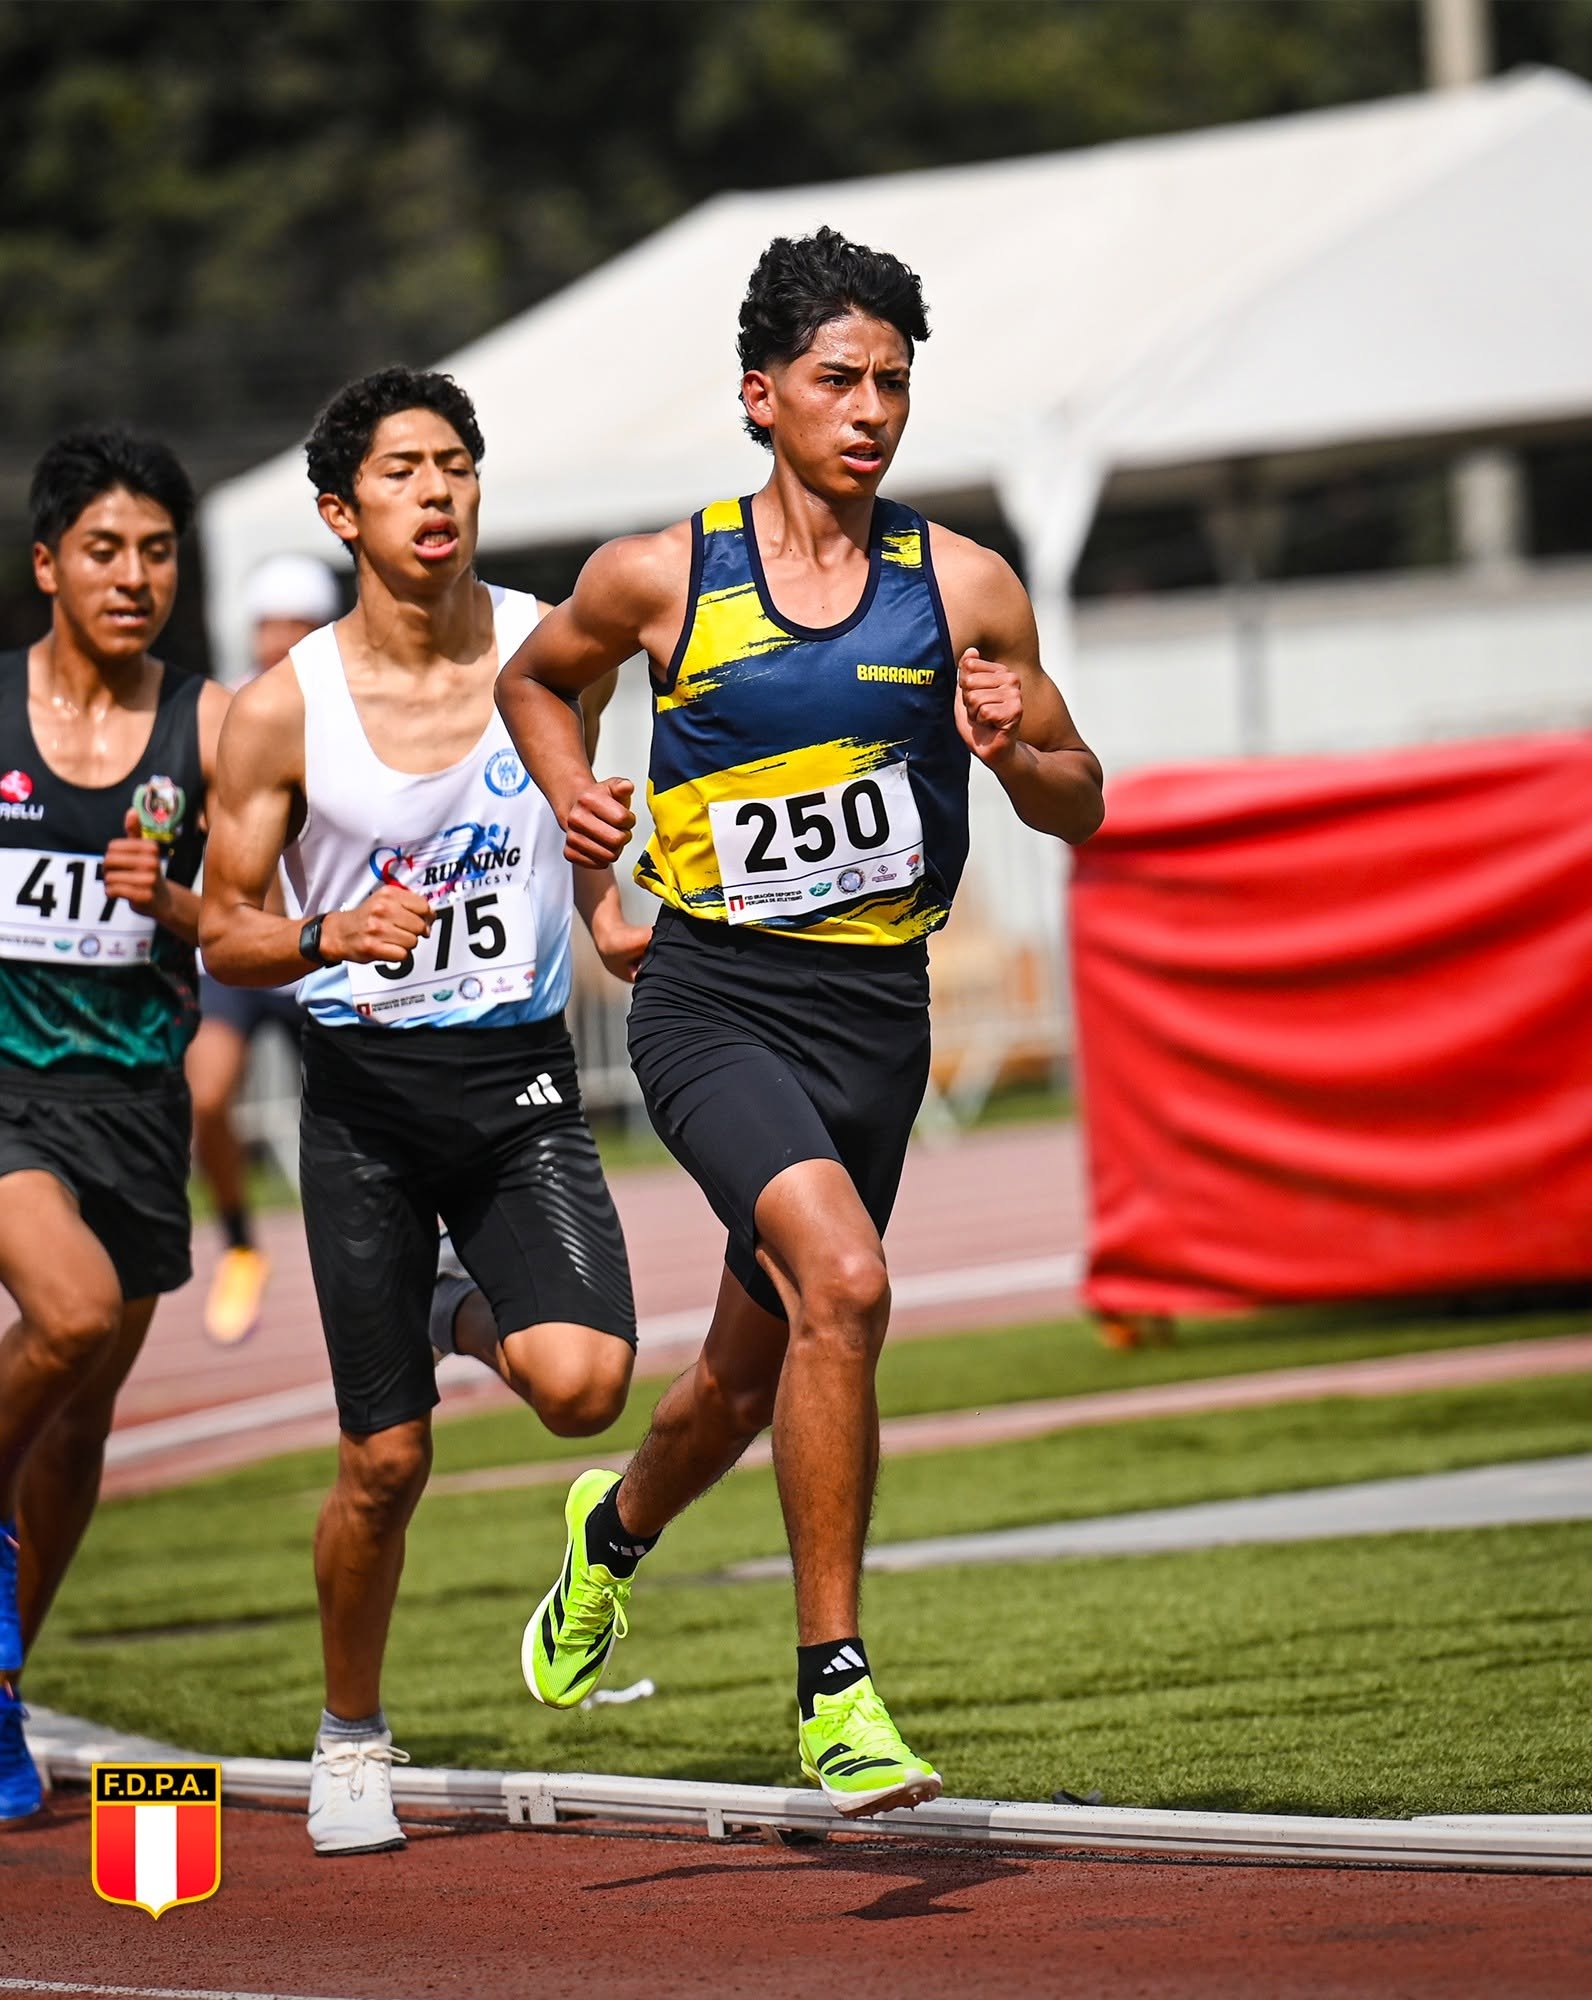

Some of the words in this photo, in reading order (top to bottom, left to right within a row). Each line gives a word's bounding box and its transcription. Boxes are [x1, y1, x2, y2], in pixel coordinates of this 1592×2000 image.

[857, 664, 934, 685] BARRANCO
[735, 779, 890, 874] 250
[423, 847, 520, 886] RUNNING
